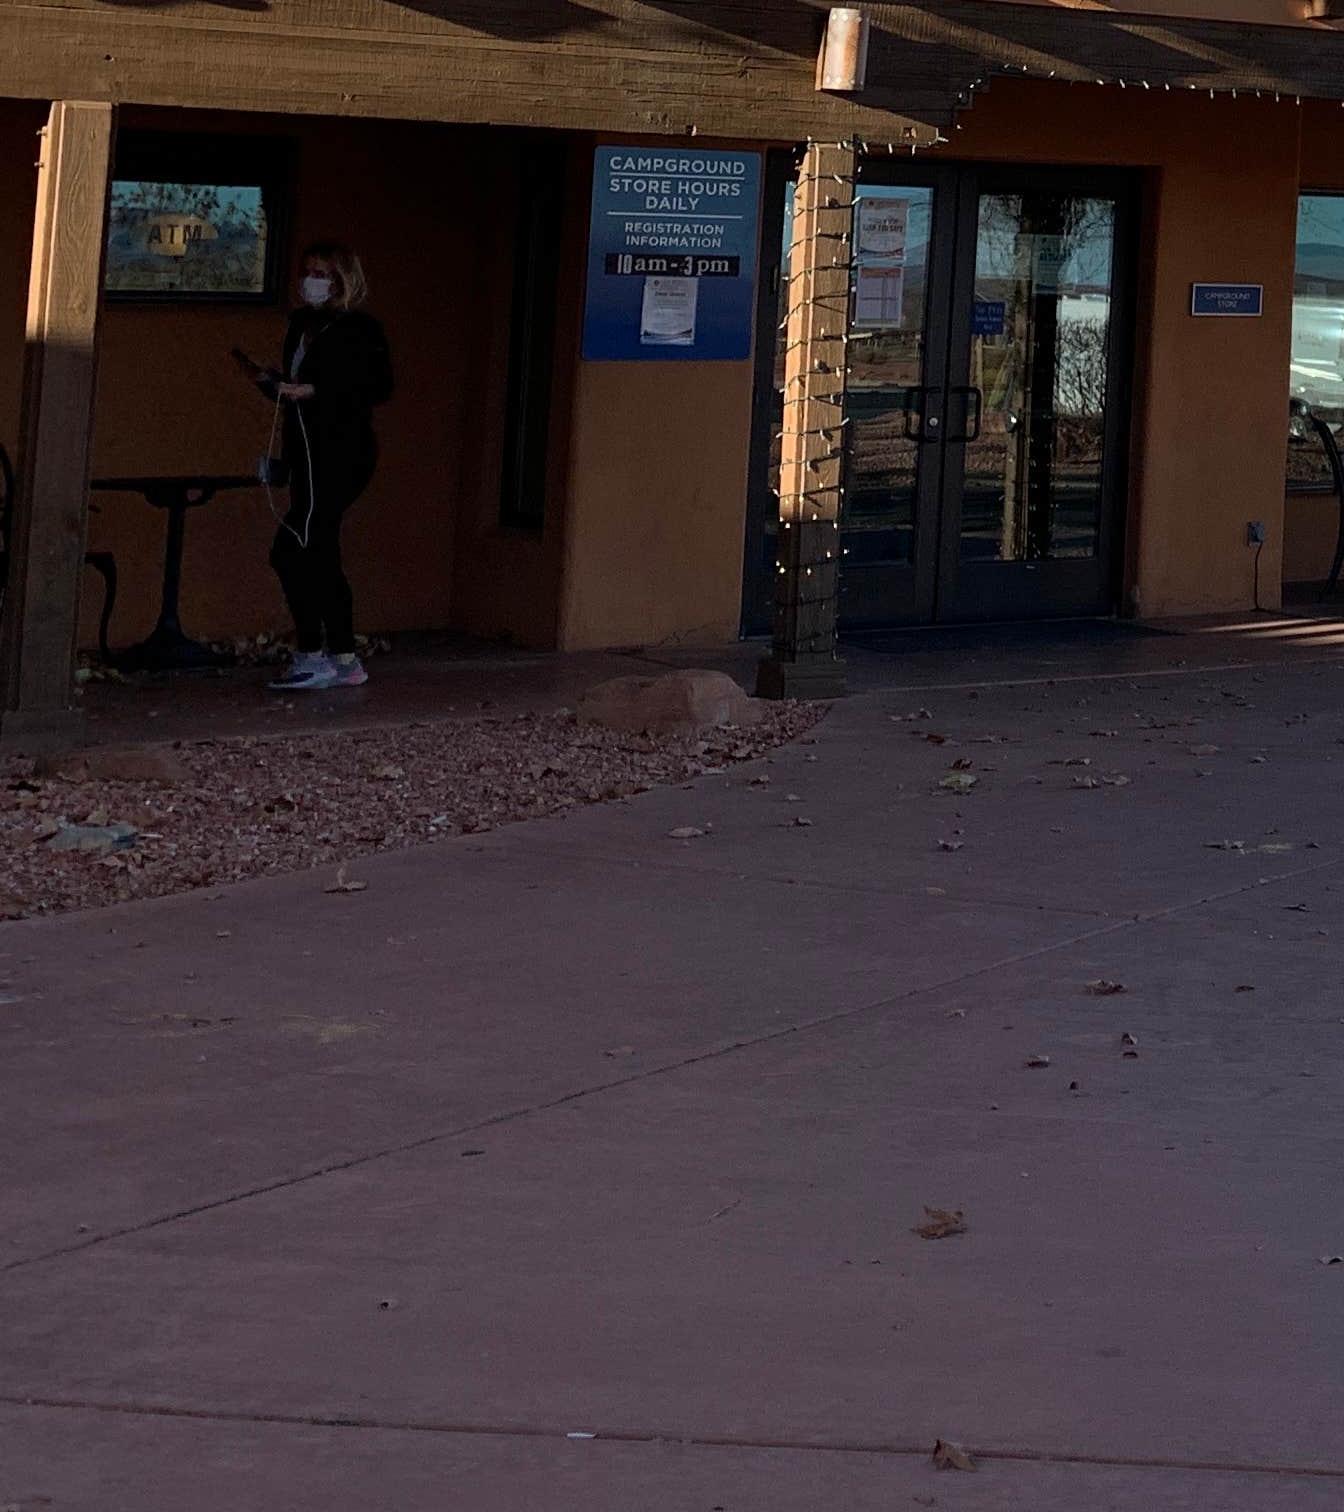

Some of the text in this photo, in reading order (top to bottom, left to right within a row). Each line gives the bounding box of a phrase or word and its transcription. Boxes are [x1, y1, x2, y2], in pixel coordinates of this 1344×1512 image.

[610, 157, 745, 174] CAMPGROUND
[609, 179, 741, 196] STORE HOURS
[645, 196, 699, 210] DAILY
[147, 225, 202, 244] ATM
[625, 222, 724, 235] REGISTRATION
[626, 236, 722, 248] INFORMATION
